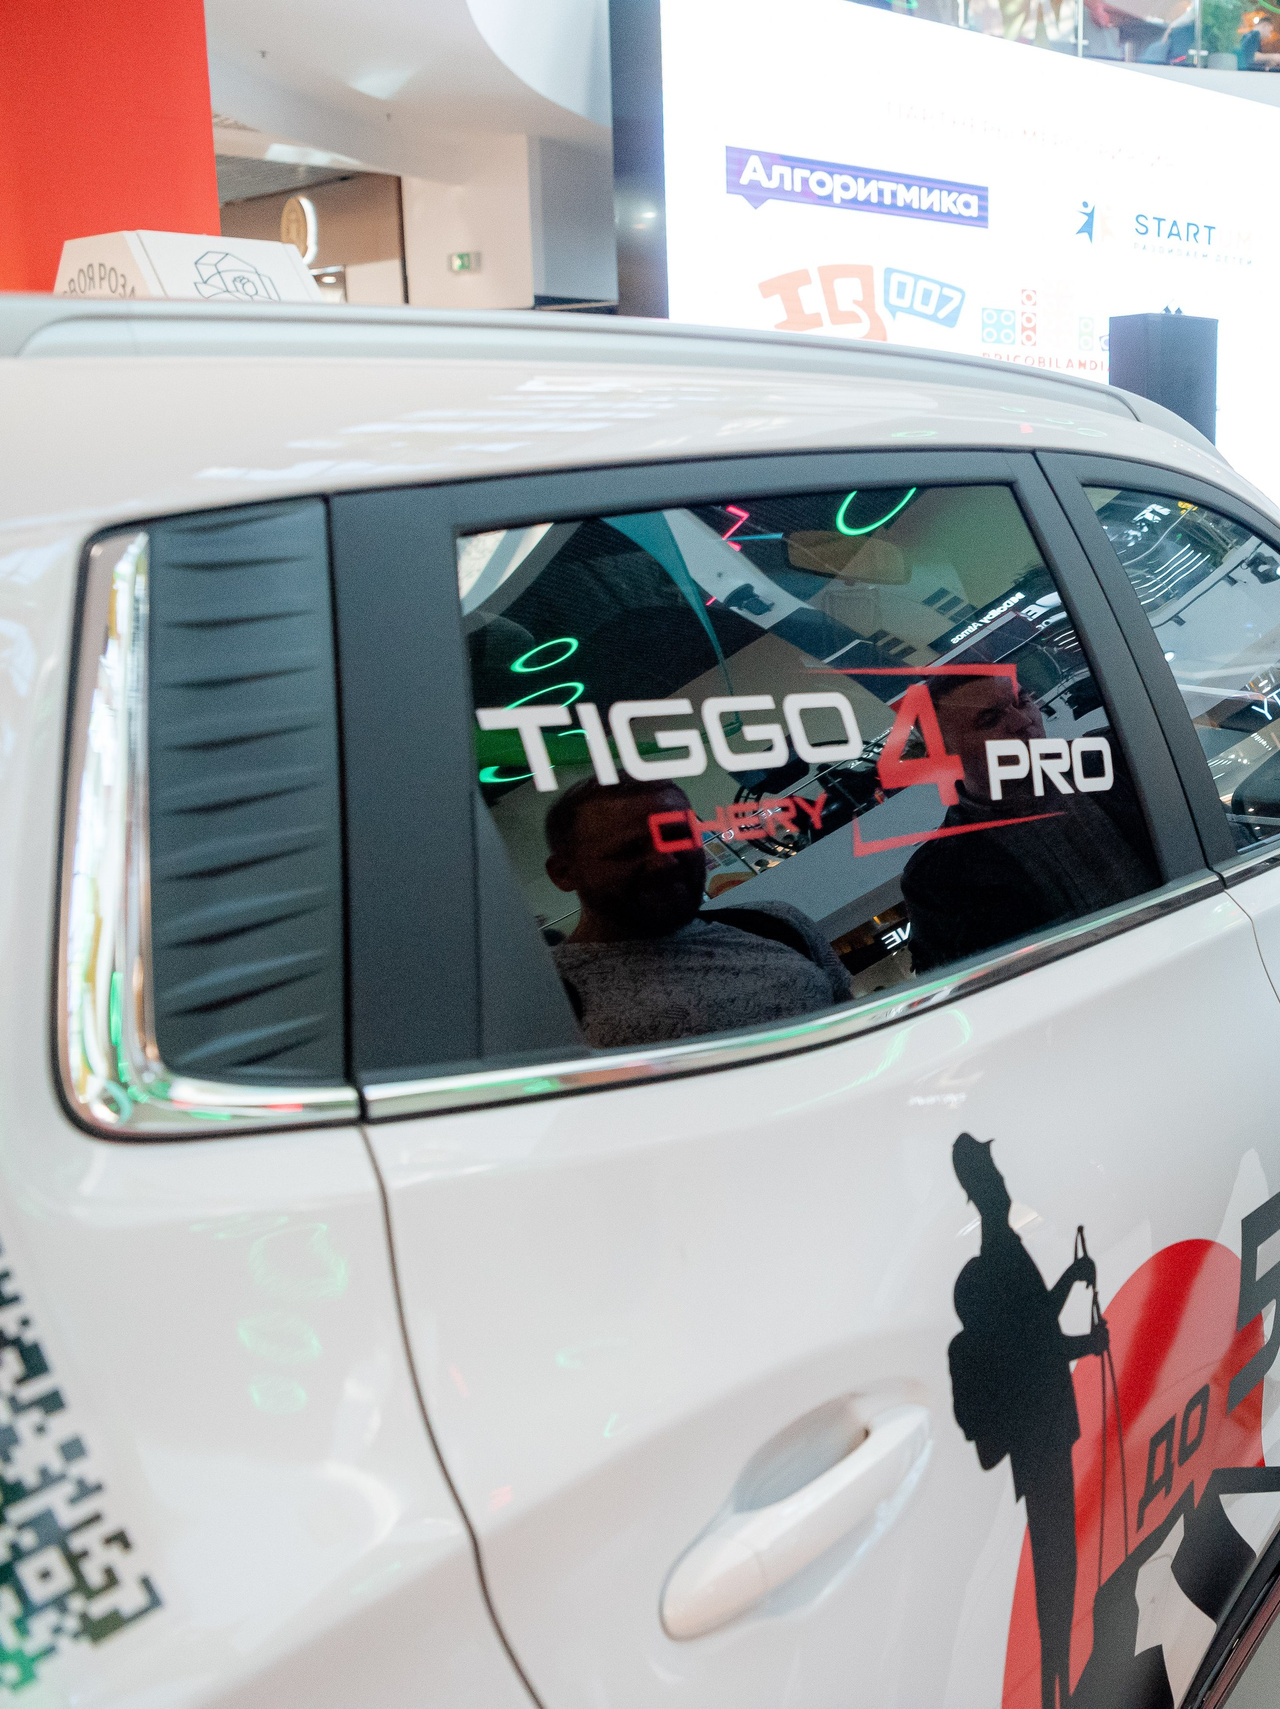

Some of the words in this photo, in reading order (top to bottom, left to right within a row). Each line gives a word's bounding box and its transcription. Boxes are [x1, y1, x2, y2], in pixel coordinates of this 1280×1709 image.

[739, 155, 980, 218] Алгоритмика
[62, 262, 96, 296] ВОЯ
[888, 271, 963, 320] 007
[982, 351, 1110, 373] BRICOBILANDI
[476, 692, 864, 793] TIGGO
[876, 684, 965, 806] 4
[986, 736, 1114, 802] PRO
[648, 792, 830, 854] CHERY
[1135, 1383, 1210, 1534] до
